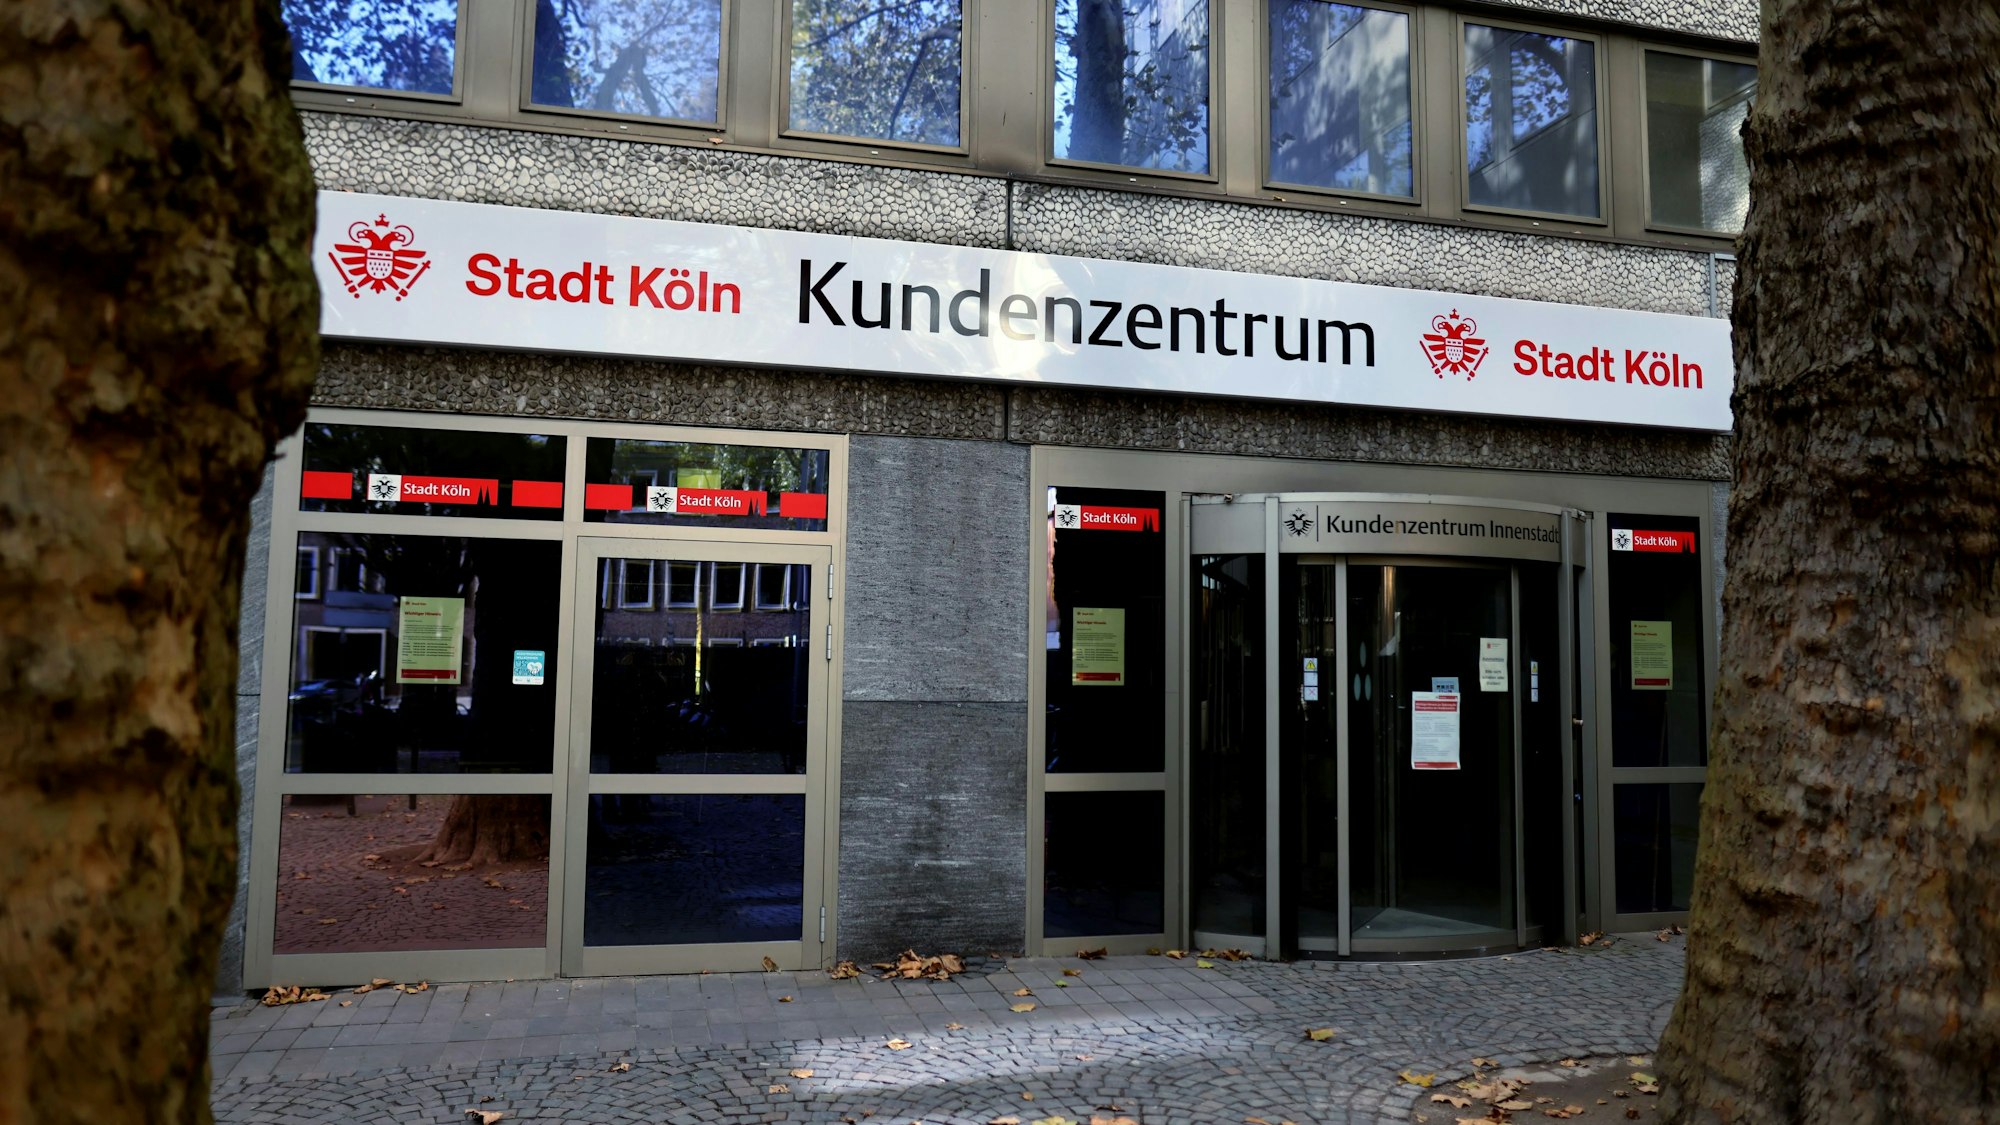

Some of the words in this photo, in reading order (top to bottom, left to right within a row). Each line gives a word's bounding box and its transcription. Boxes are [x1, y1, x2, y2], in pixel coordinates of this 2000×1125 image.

[465, 252, 615, 305] Stadt
[629, 265, 741, 315] Köln
[798, 258, 1375, 367] Kundenzentrum
[1513, 339, 1616, 383] Stadt
[1625, 349, 1703, 389] Köln
[403, 482, 438, 496] Stadt
[441, 484, 471, 497] Köln
[679, 494, 712, 507] Stadt
[714, 496, 742, 508] Köln
[1082, 511, 1112, 524] Stadt
[1113, 513, 1137, 525] Köln
[1327, 513, 1486, 538] Kundenzentrum
[1490, 519, 1561, 543] Innenstadt
[1634, 535, 1657, 547] Stadt
[1658, 536, 1678, 547] Köln
